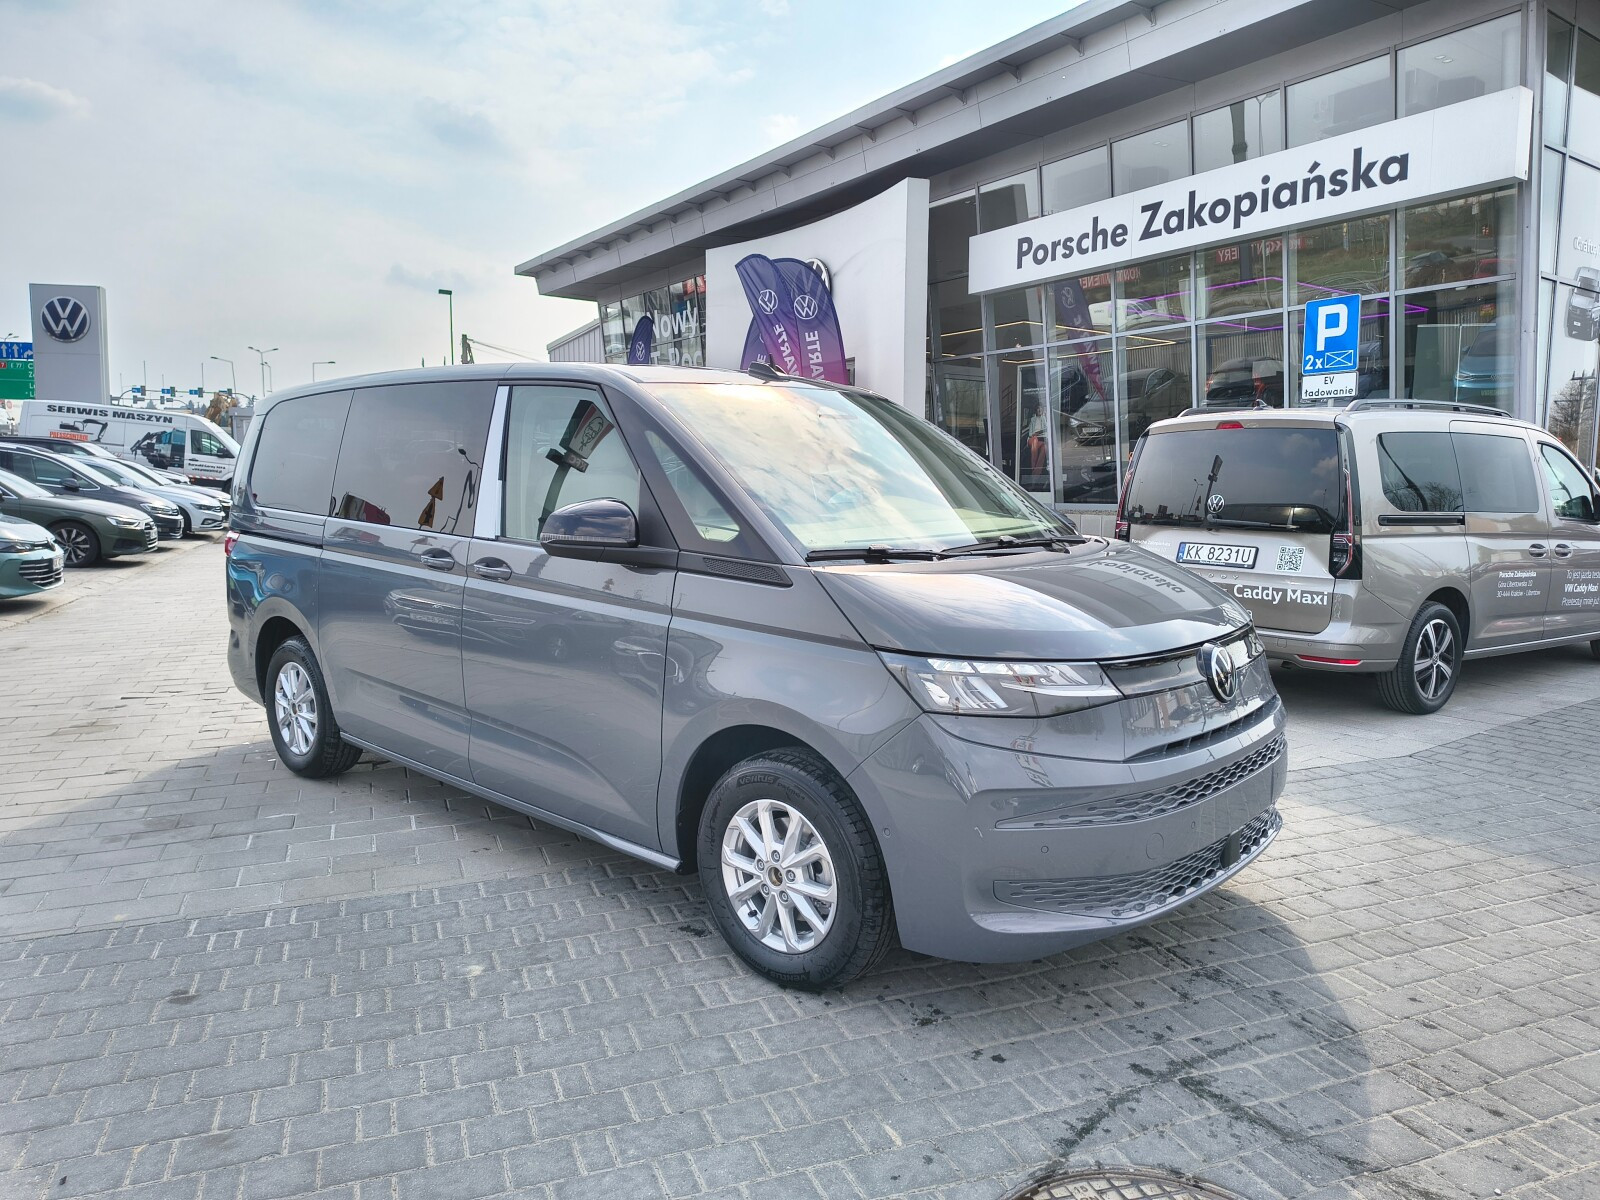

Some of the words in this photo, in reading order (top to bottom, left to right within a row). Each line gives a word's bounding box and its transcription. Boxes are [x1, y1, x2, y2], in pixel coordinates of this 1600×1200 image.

[1016, 217, 1128, 270] Porsche
[1139, 146, 1410, 242] Zakopiańska
[1316, 303, 1348, 352] P
[1304, 354, 1324, 371] 2x
[1323, 376, 1335, 385] EV
[1304, 386, 1354, 397] ładowanie
[46, 404, 109, 417] SERWIS
[112, 410, 173, 424] MASZYN
[1186, 544, 1204, 560] KK
[1207, 546, 1252, 564] 8231U
[1233, 584, 1283, 605] Caddy
[1287, 589, 1328, 606] Maxi
[1564, 583, 1573, 592] VW
